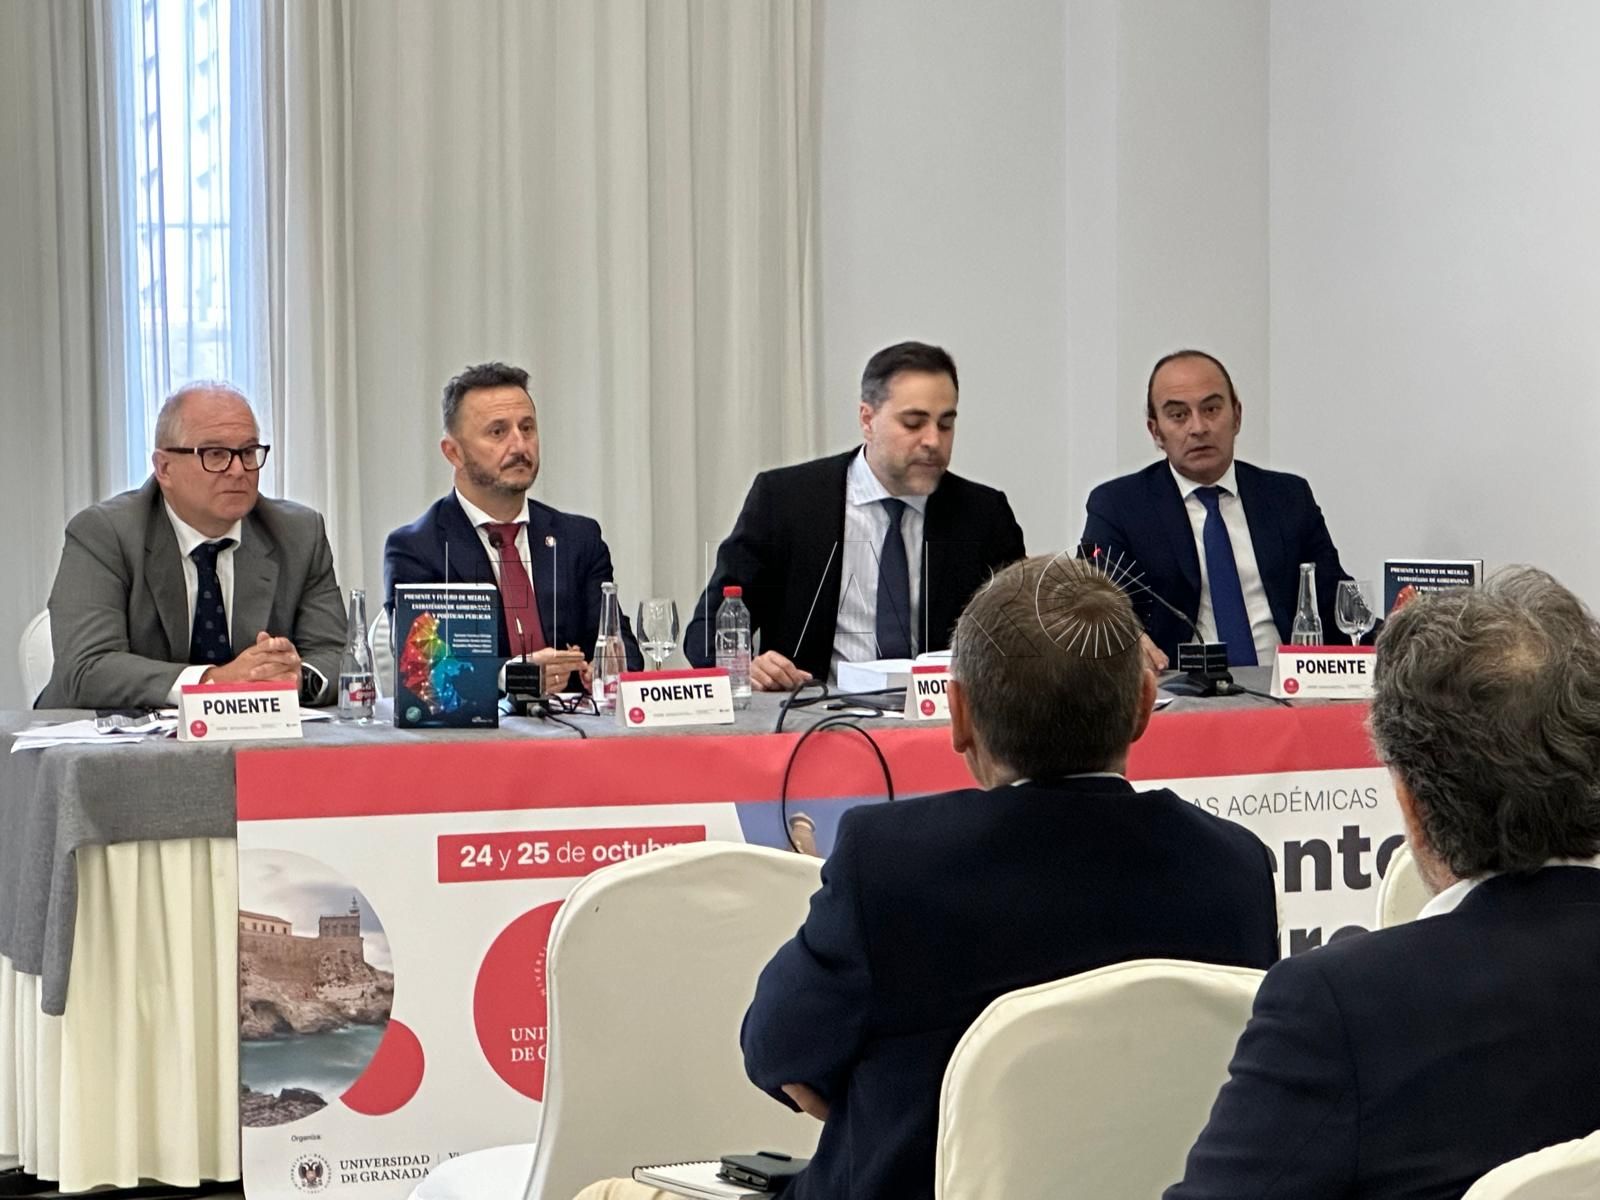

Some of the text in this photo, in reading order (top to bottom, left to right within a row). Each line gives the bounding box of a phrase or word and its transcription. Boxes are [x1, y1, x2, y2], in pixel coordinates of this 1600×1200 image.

[1296, 659, 1367, 674] PONENTE
[640, 683, 714, 703] PONENTE
[203, 697, 281, 715] PONENTE
[1227, 786, 1378, 817] ACADÉMICAS
[460, 837, 676, 871] 24 y 25 de octub
[511, 1046, 535, 1062] DE
[340, 1155, 430, 1170] UNIVERSIDAD
[340, 1167, 430, 1184] DE GRANADA
